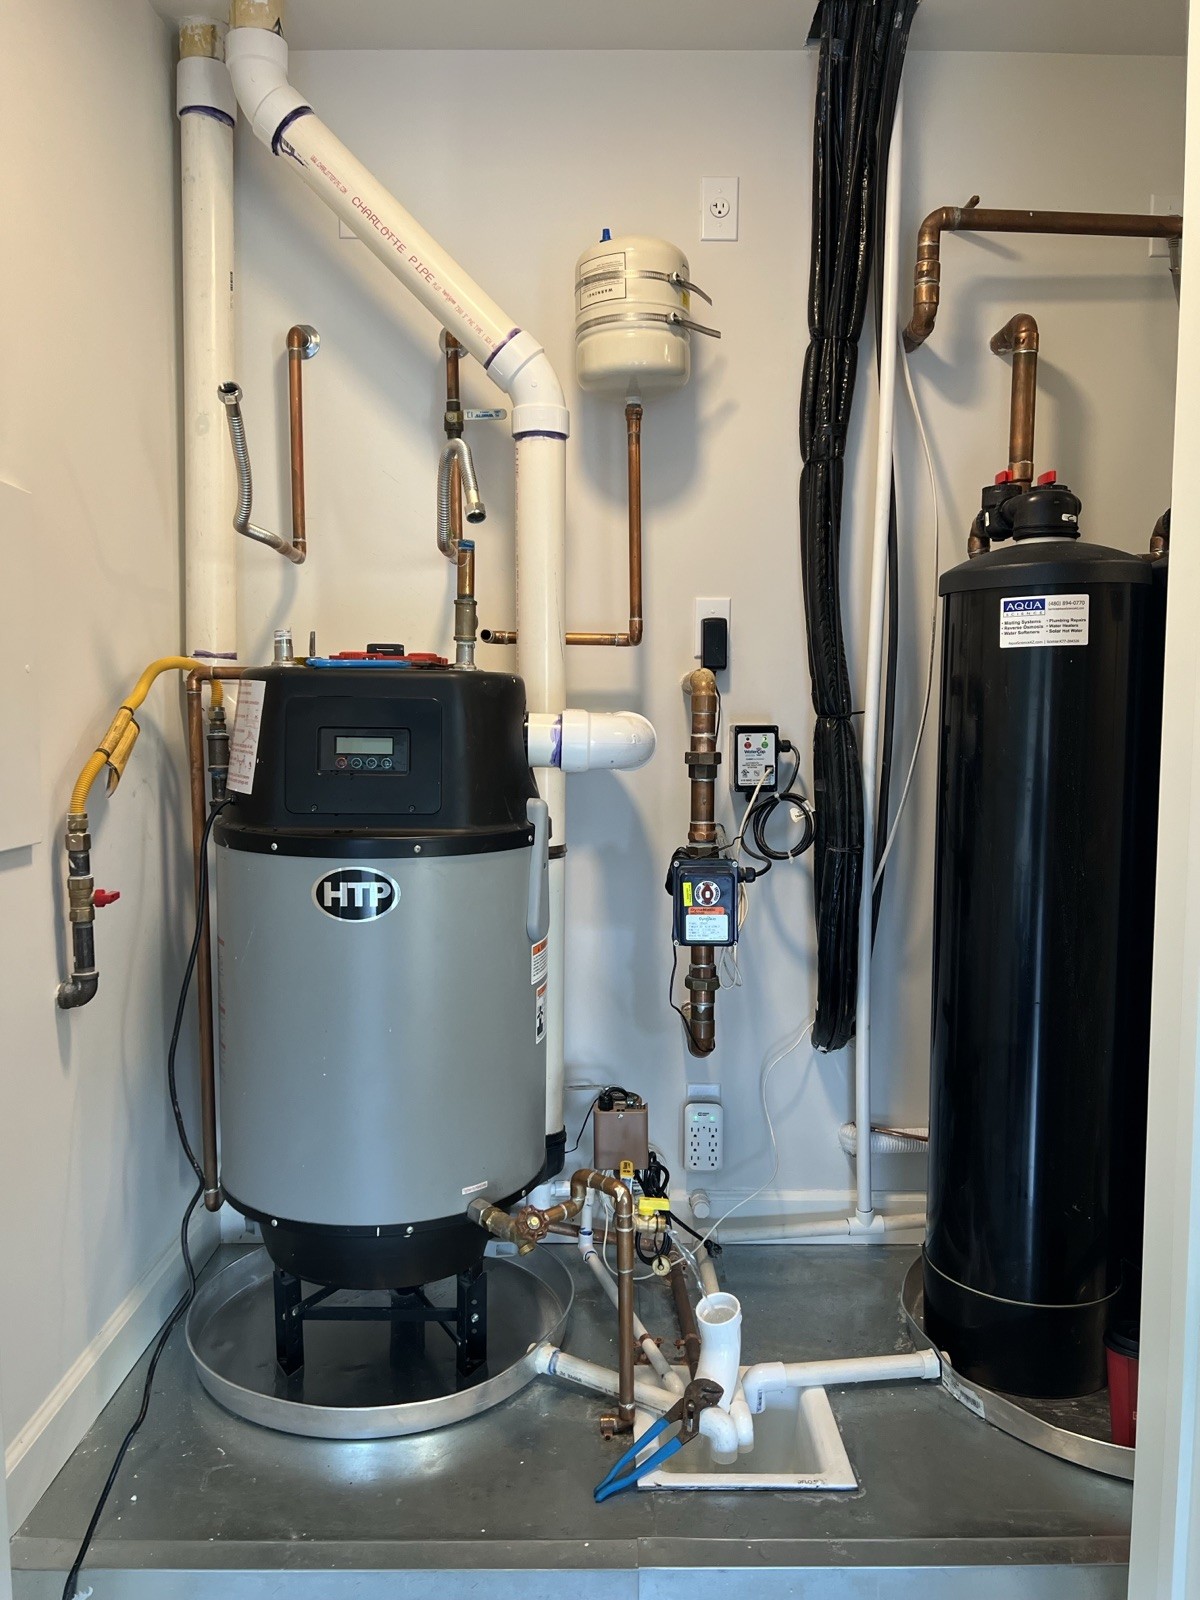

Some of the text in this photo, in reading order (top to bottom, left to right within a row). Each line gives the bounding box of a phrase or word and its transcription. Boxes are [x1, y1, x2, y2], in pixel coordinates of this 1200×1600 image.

[351, 196, 407, 254] CHARLOTTE
[408, 255, 435, 283] PIPE
[1006, 601, 1043, 611] AQUA
[323, 882, 391, 907] HTP
